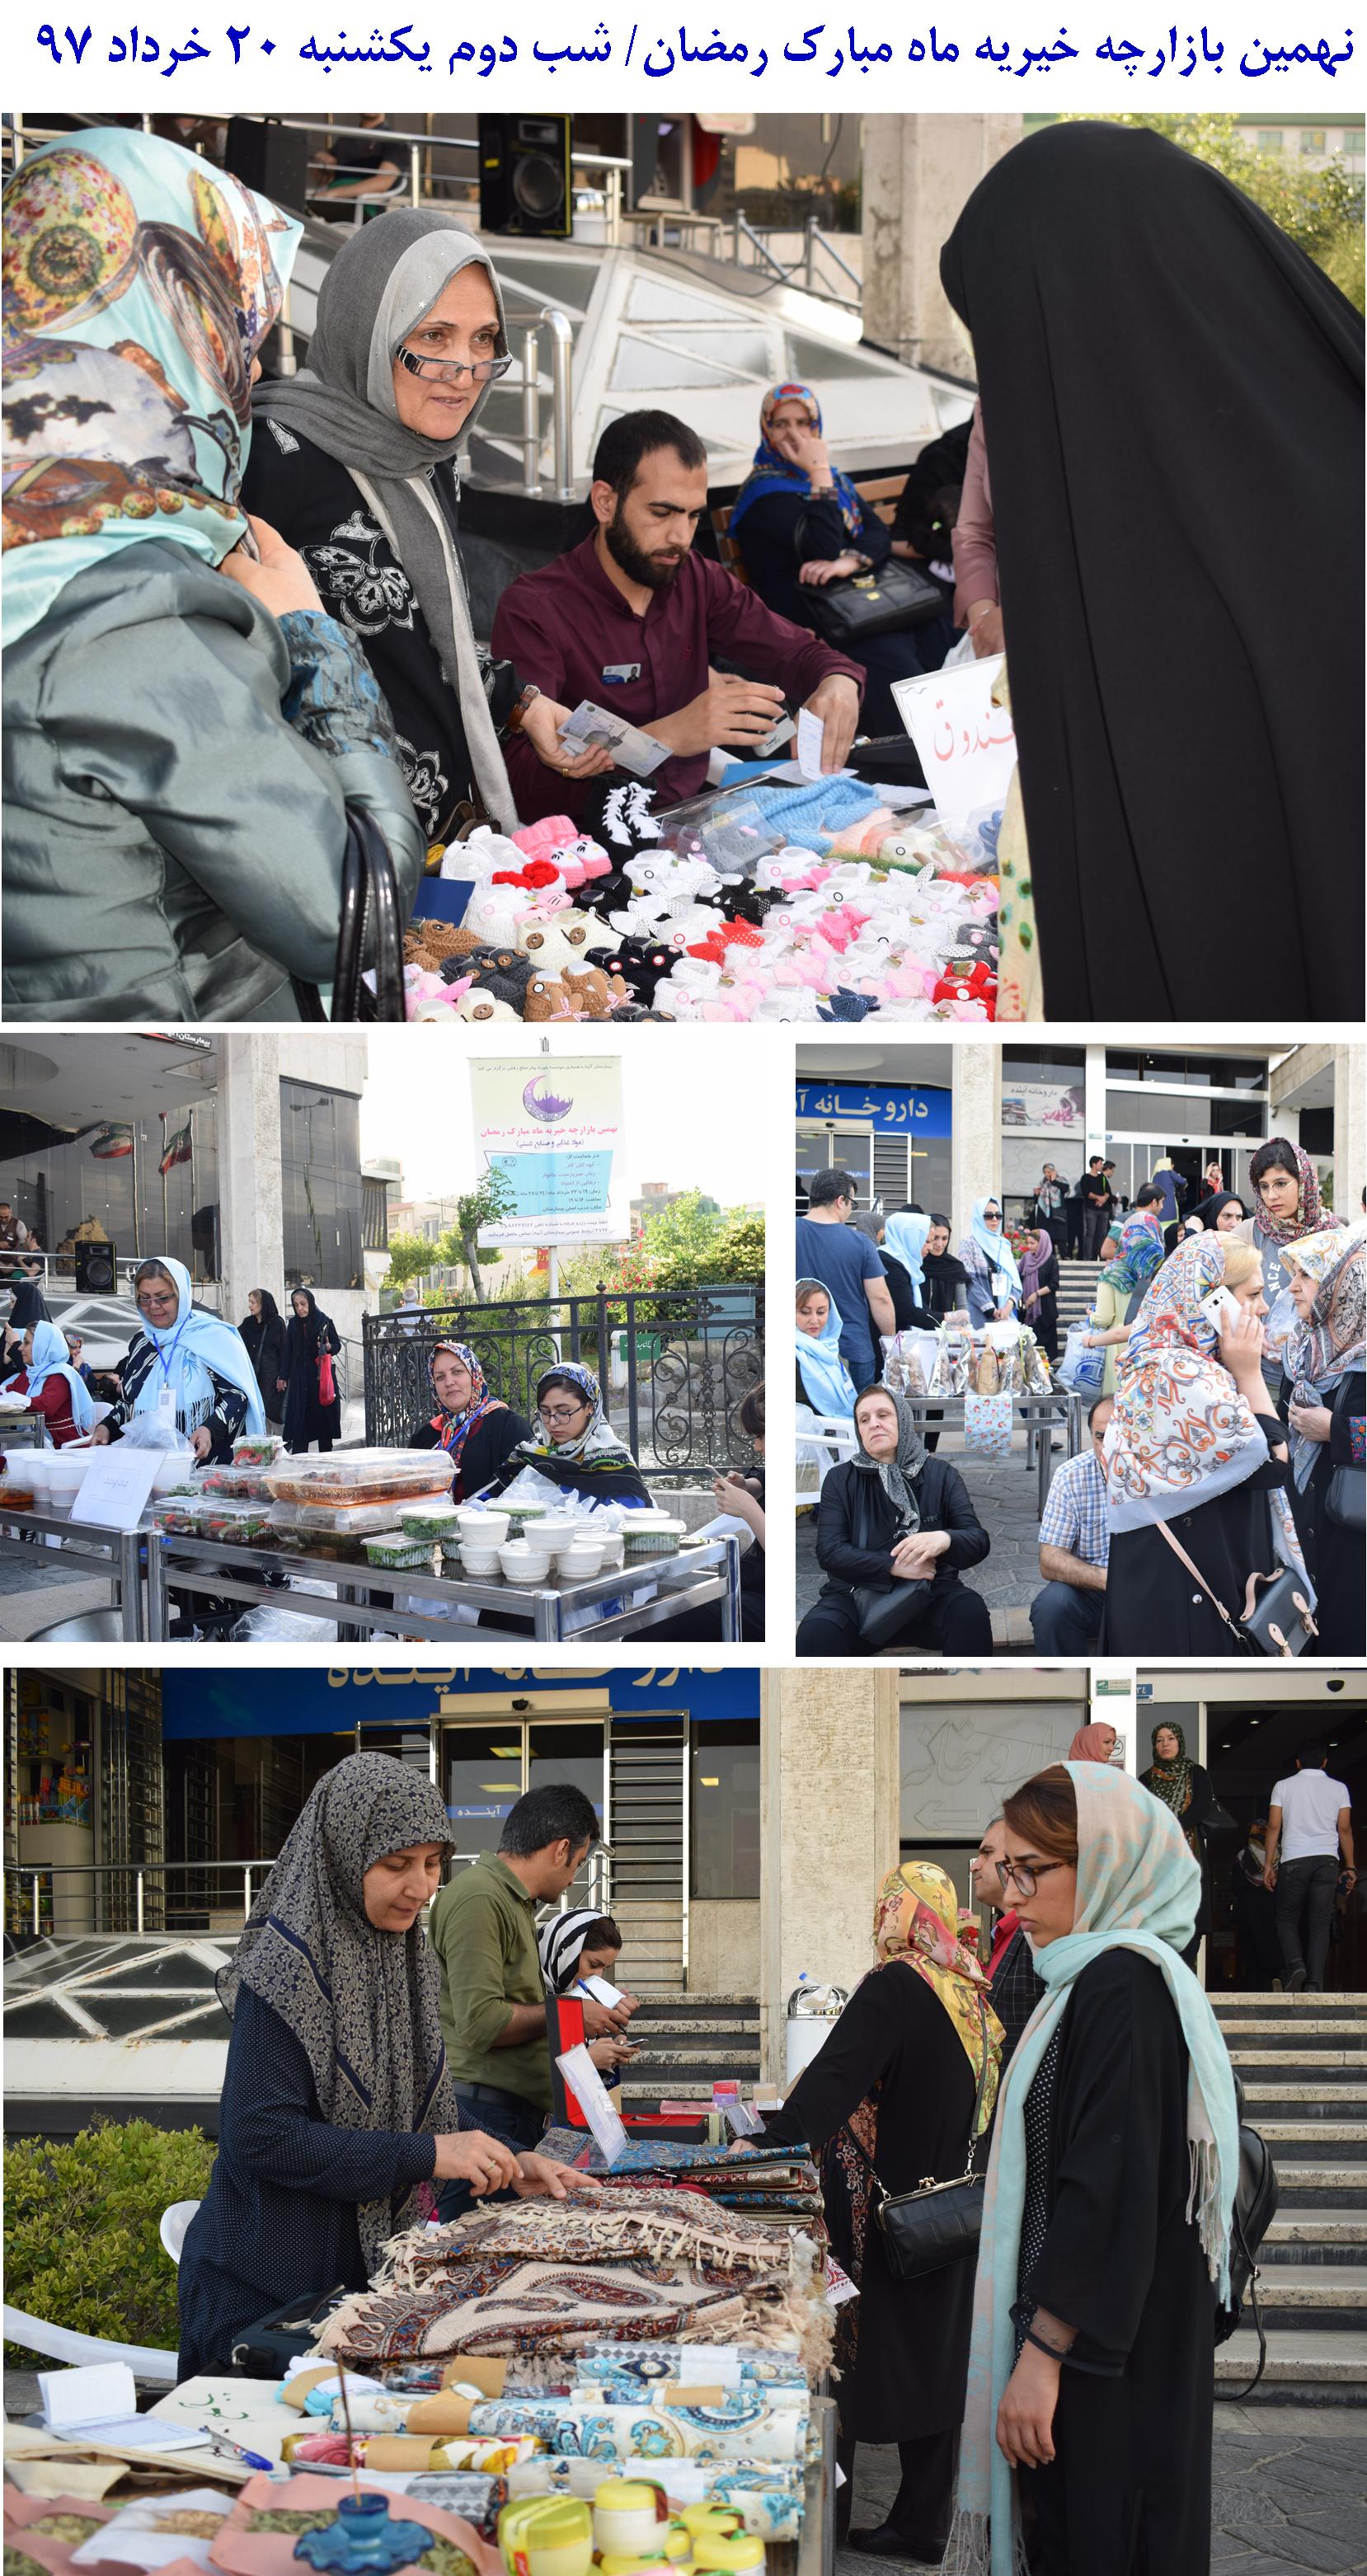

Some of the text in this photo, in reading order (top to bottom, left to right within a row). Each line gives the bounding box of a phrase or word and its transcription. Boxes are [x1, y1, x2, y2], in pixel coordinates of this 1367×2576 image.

[933, 699, 1016, 762] ندوق
[815, 1094, 928, 1122] داروخانه
[480, 1125, 618, 1138] نهمین بازارچه خیریه ماه مبارک رمضان
[458, 1804, 501, 1818] آینده
